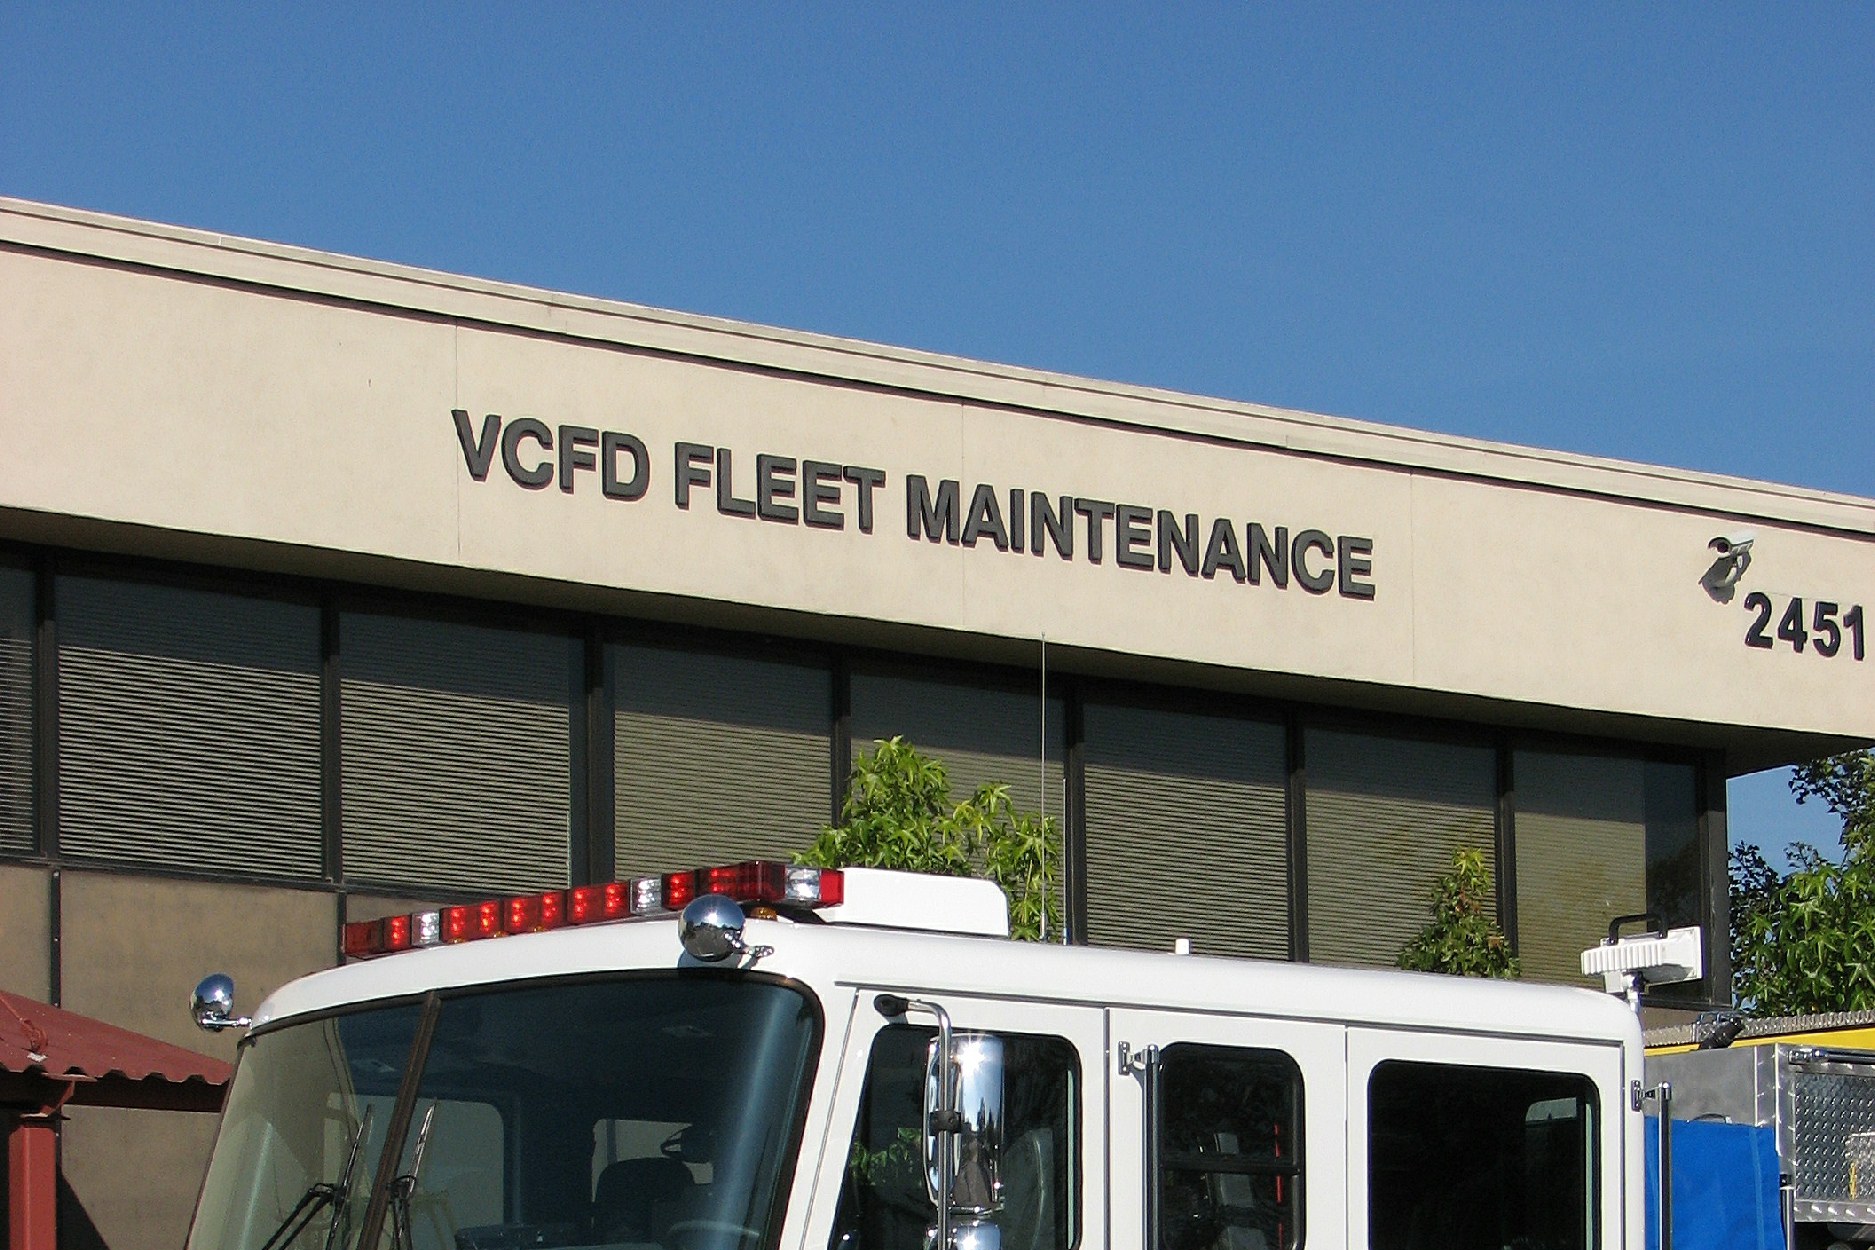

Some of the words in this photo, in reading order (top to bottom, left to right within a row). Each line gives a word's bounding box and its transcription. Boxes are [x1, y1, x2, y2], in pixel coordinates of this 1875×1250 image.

[451, 409, 650, 502] VCFD
[674, 441, 886, 535] FLEET
[906, 473, 1376, 600] MAINTENANCE
[1744, 592, 1865, 661] 2451
